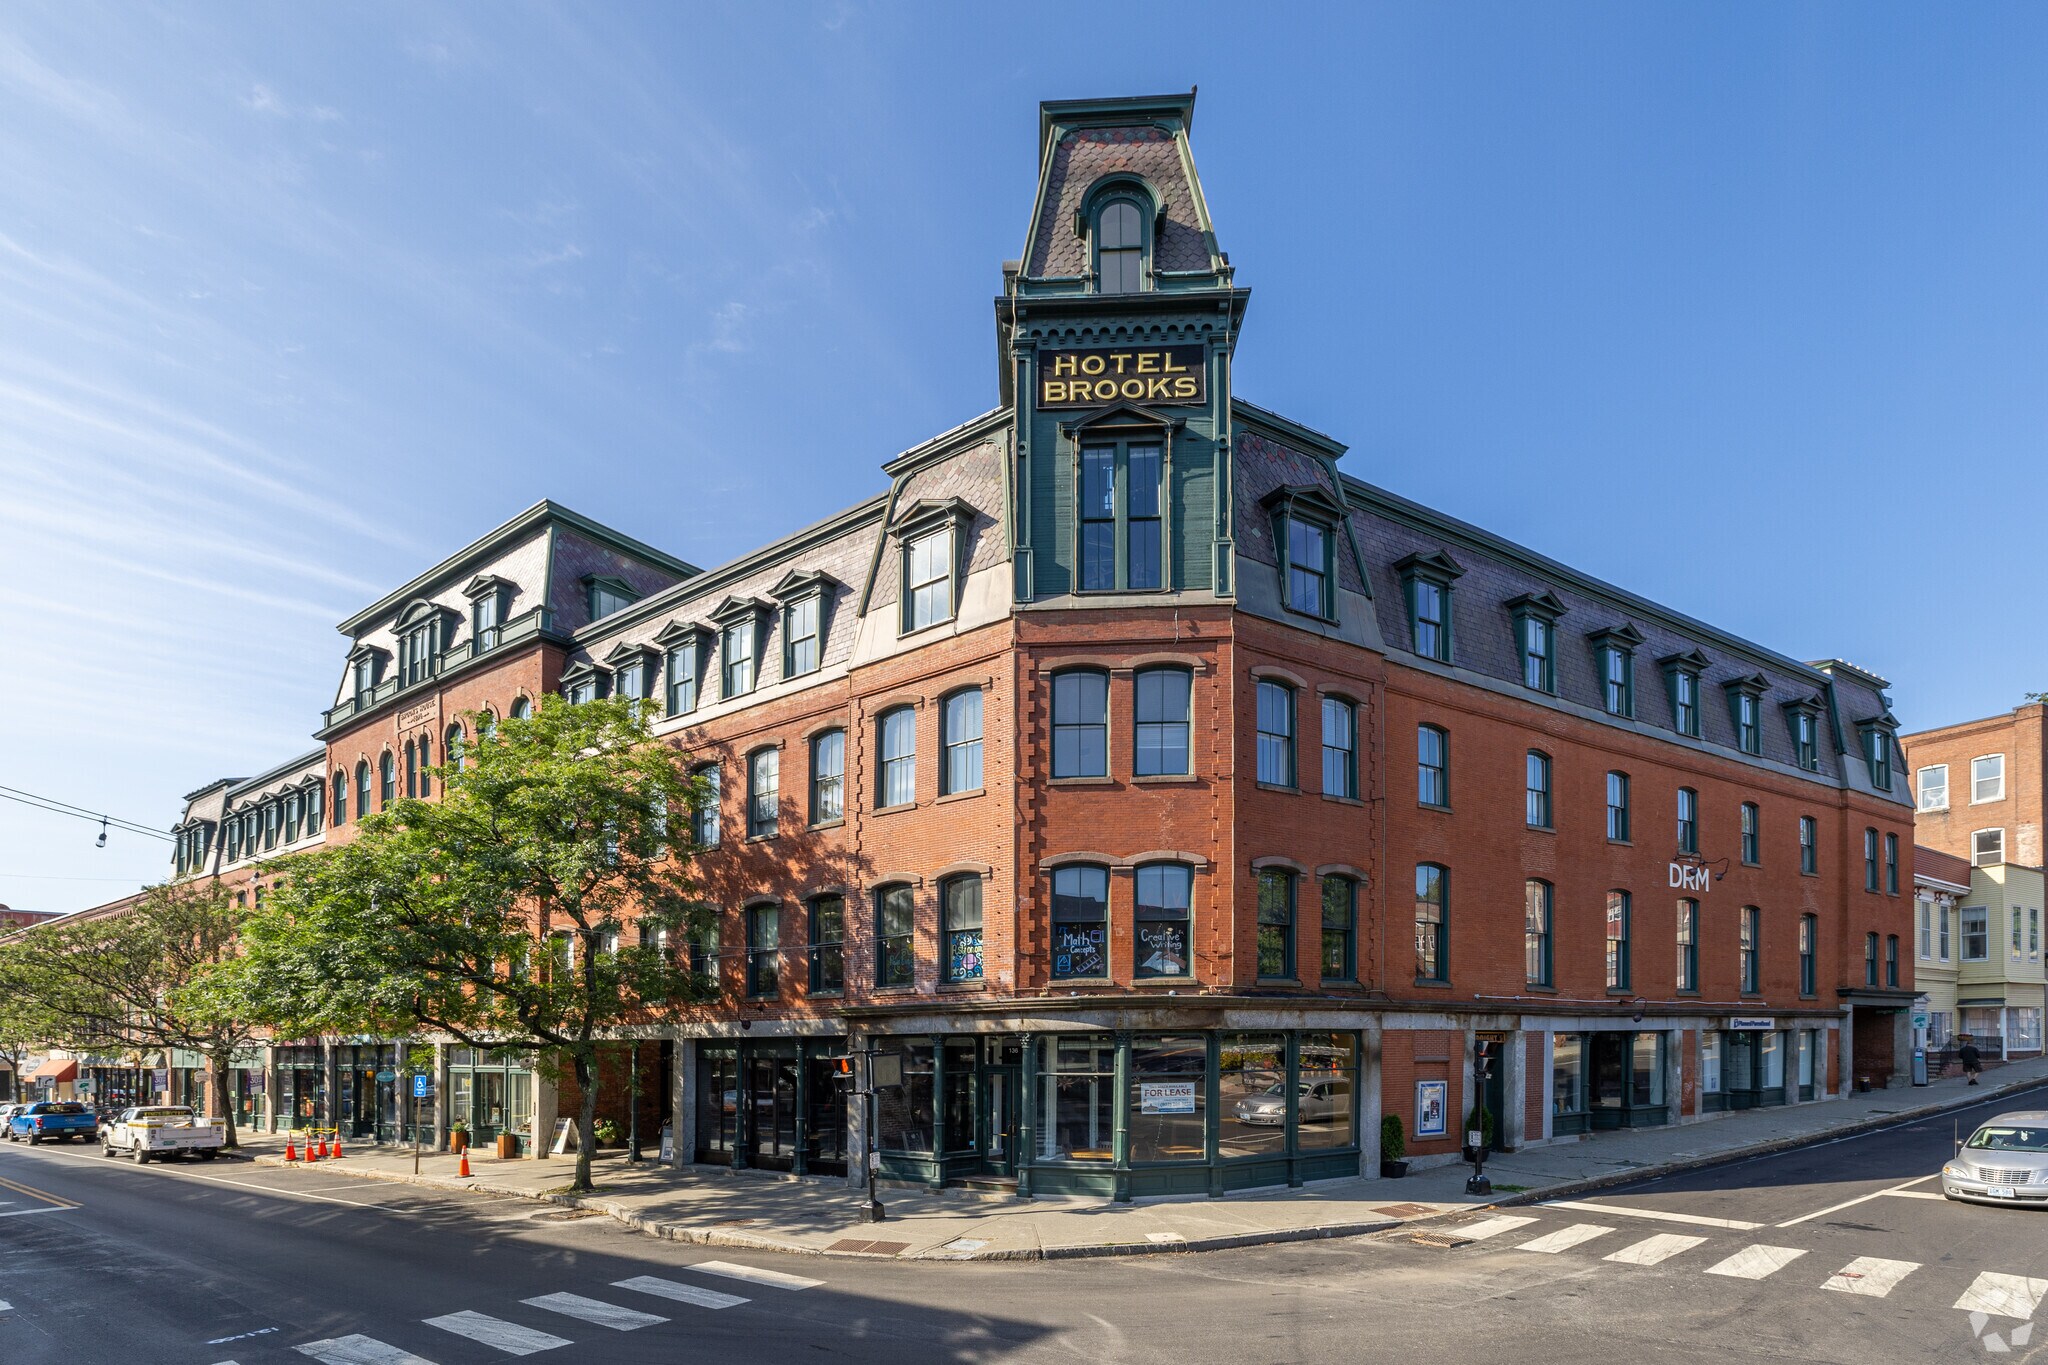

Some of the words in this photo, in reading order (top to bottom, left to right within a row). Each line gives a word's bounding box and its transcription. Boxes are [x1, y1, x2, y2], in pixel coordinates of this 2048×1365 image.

[1055, 352, 1187, 376] HOTEL
[1044, 377, 1198, 402] BROOKS
[1669, 863, 1710, 892] DRM
[1063, 932, 1091, 946] Math
[1144, 1089, 1163, 1097] FOR
[1164, 1088, 1192, 1097] LEASE
